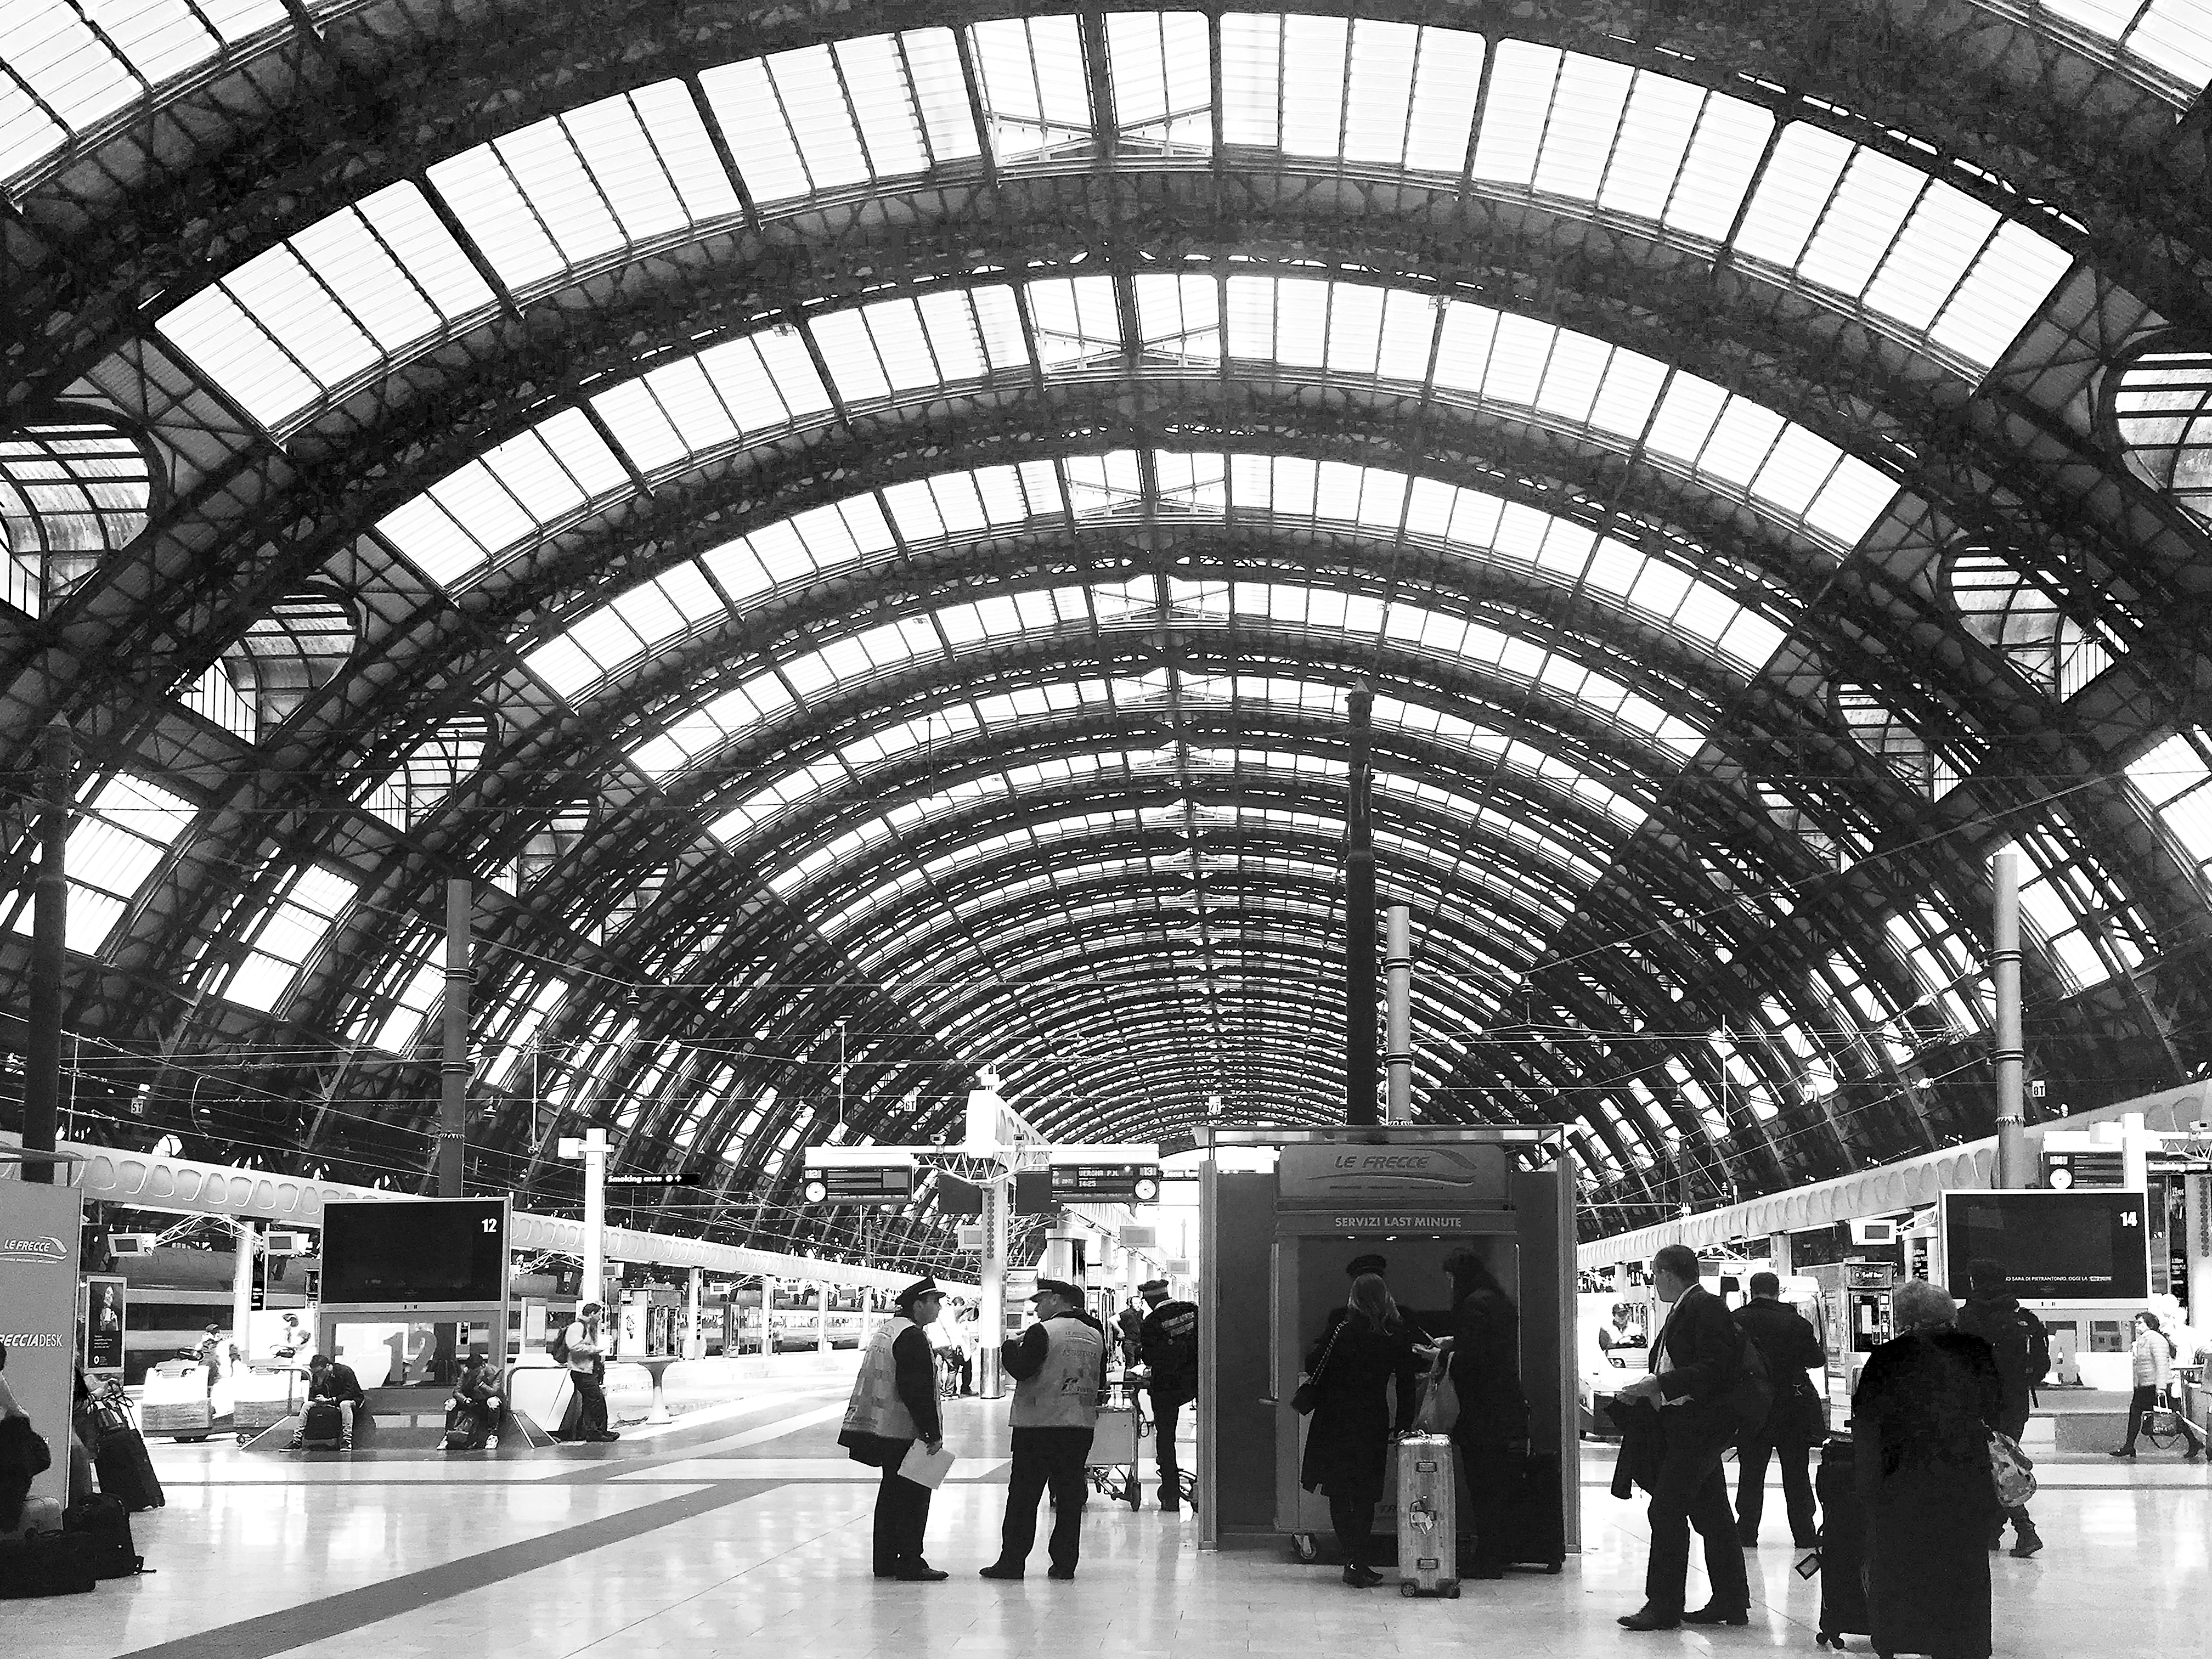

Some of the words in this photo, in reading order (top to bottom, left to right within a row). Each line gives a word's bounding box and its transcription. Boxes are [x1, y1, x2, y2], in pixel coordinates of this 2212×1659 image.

[2034, 1086, 2044, 1096] 8T
[905, 1101, 915, 1110] 6T
[1334, 1155, 1357, 1169] LE
[1362, 1156, 1430, 1169] FRECCE
[608, 1175, 642, 1184] Smoking
[481, 1218, 497, 1233] 12
[1335, 1217, 1380, 1227] SERVIZI
[1385, 1217, 1412, 1227] LAST
[1415, 1217, 1461, 1227] MINUTE
[2120, 1211, 2138, 1227] 14
[4, 1239, 16, 1250] LE
[16, 1240, 51, 1252] FRECCE
[383, 1332, 437, 1380] 12
